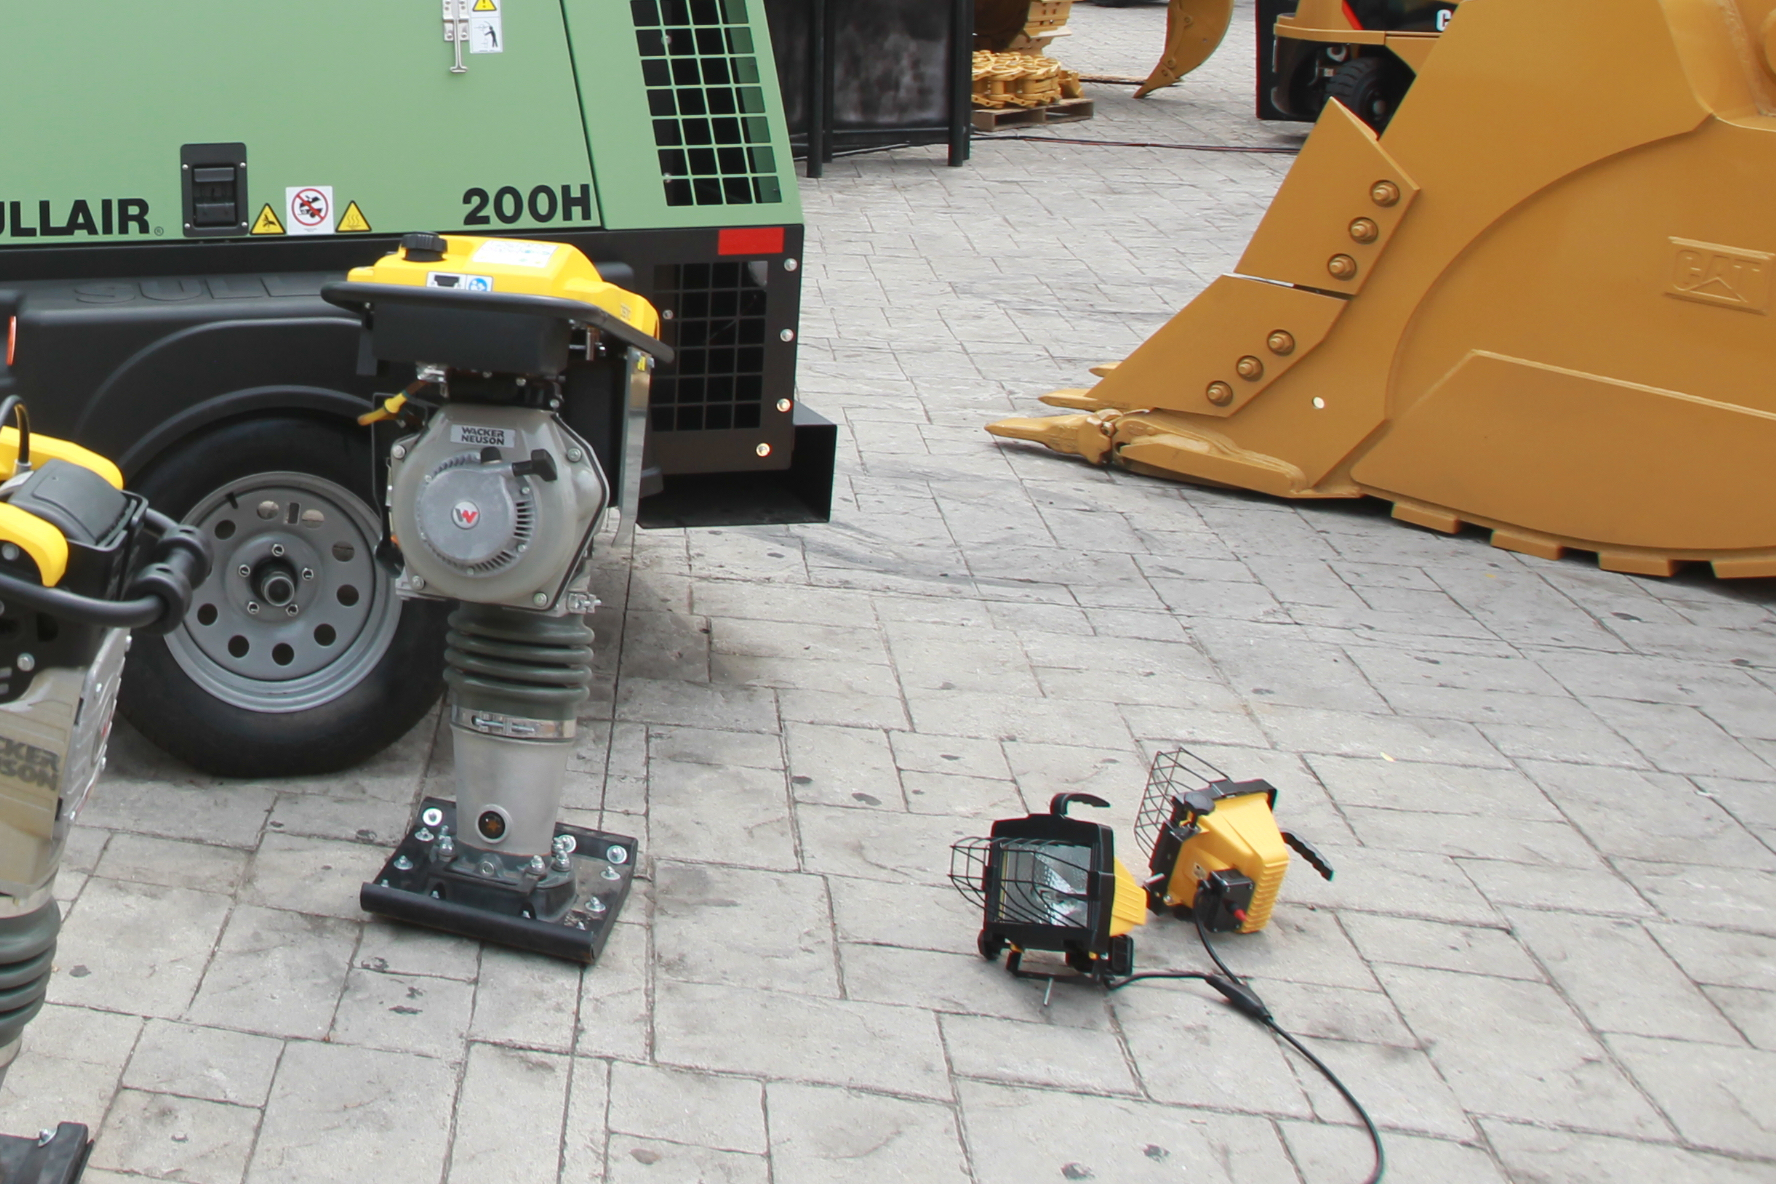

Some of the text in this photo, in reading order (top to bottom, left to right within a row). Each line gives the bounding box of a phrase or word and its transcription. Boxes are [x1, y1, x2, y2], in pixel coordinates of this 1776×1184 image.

[462, 183, 592, 226] 200H
[461, 426, 505, 437] WACKER
[461, 435, 505, 446] NEUSON
